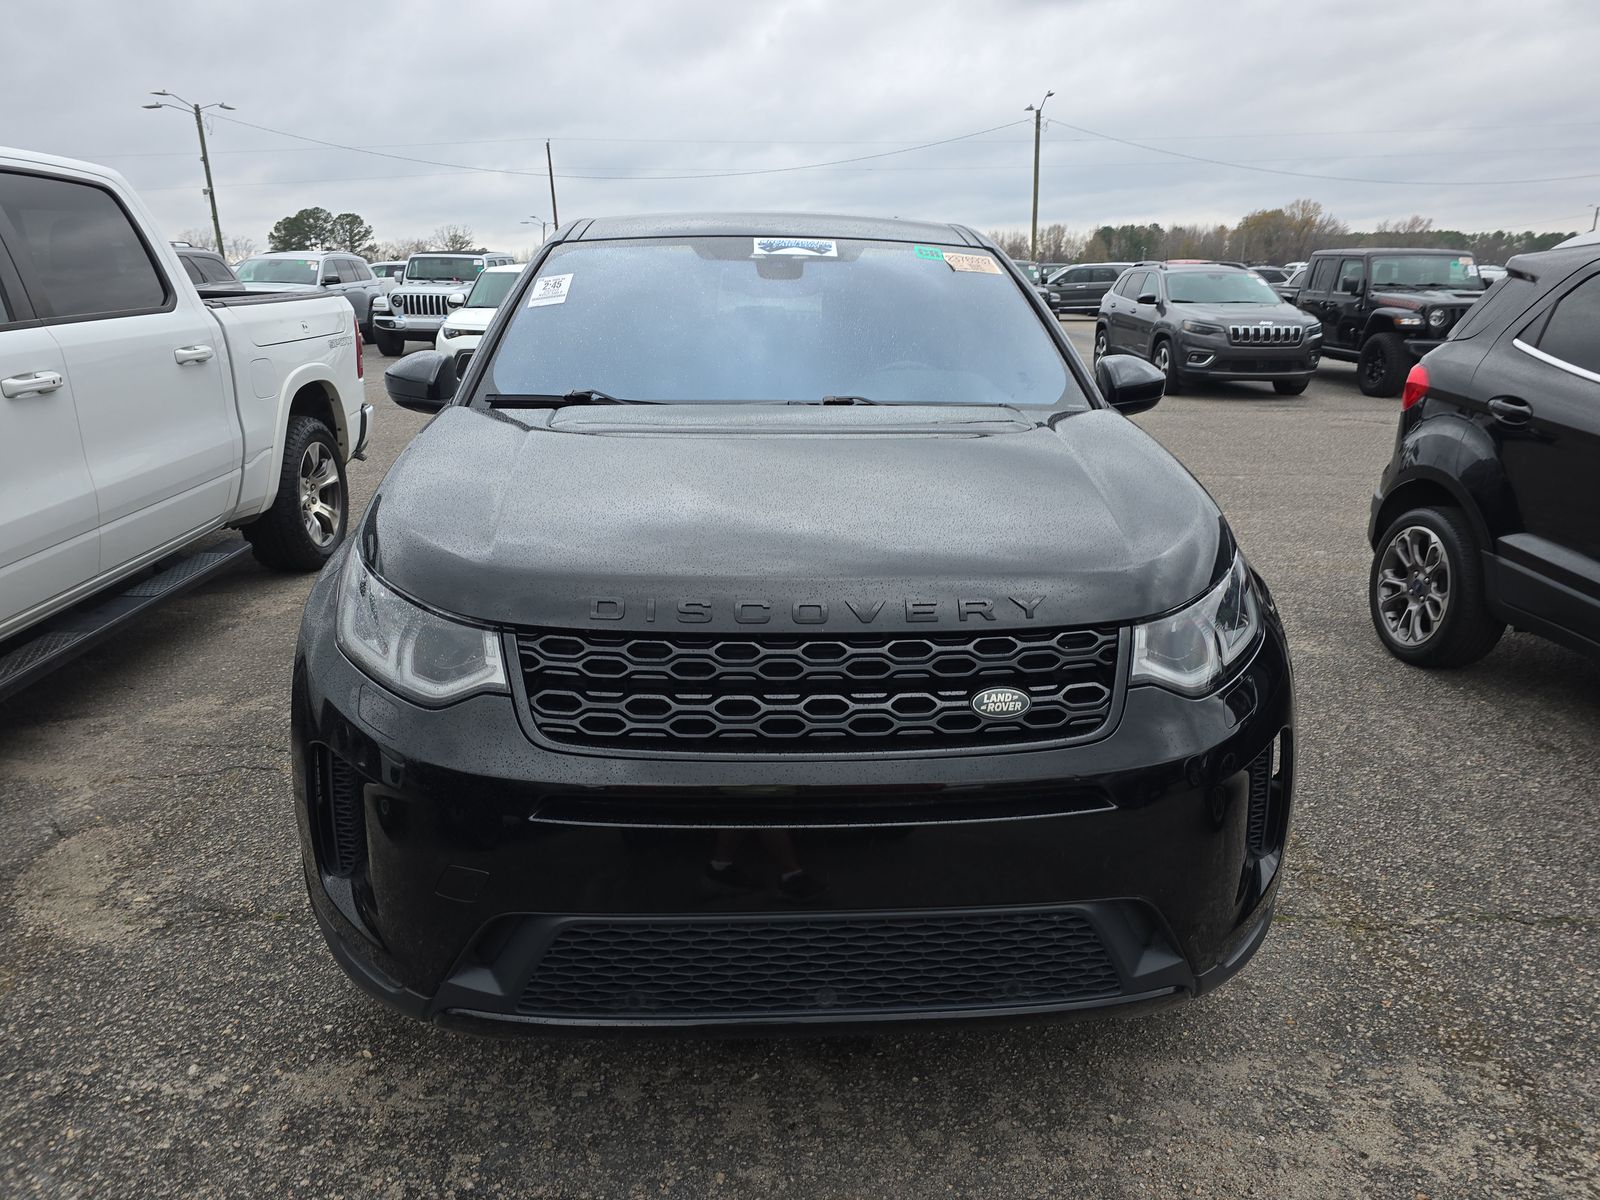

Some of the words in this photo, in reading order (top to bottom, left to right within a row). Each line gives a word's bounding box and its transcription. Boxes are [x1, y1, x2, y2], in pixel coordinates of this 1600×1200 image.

[589, 595, 1047, 624] DISCOVERY
[983, 693, 1012, 703] LAND
[987, 701, 1022, 712] ROVER
